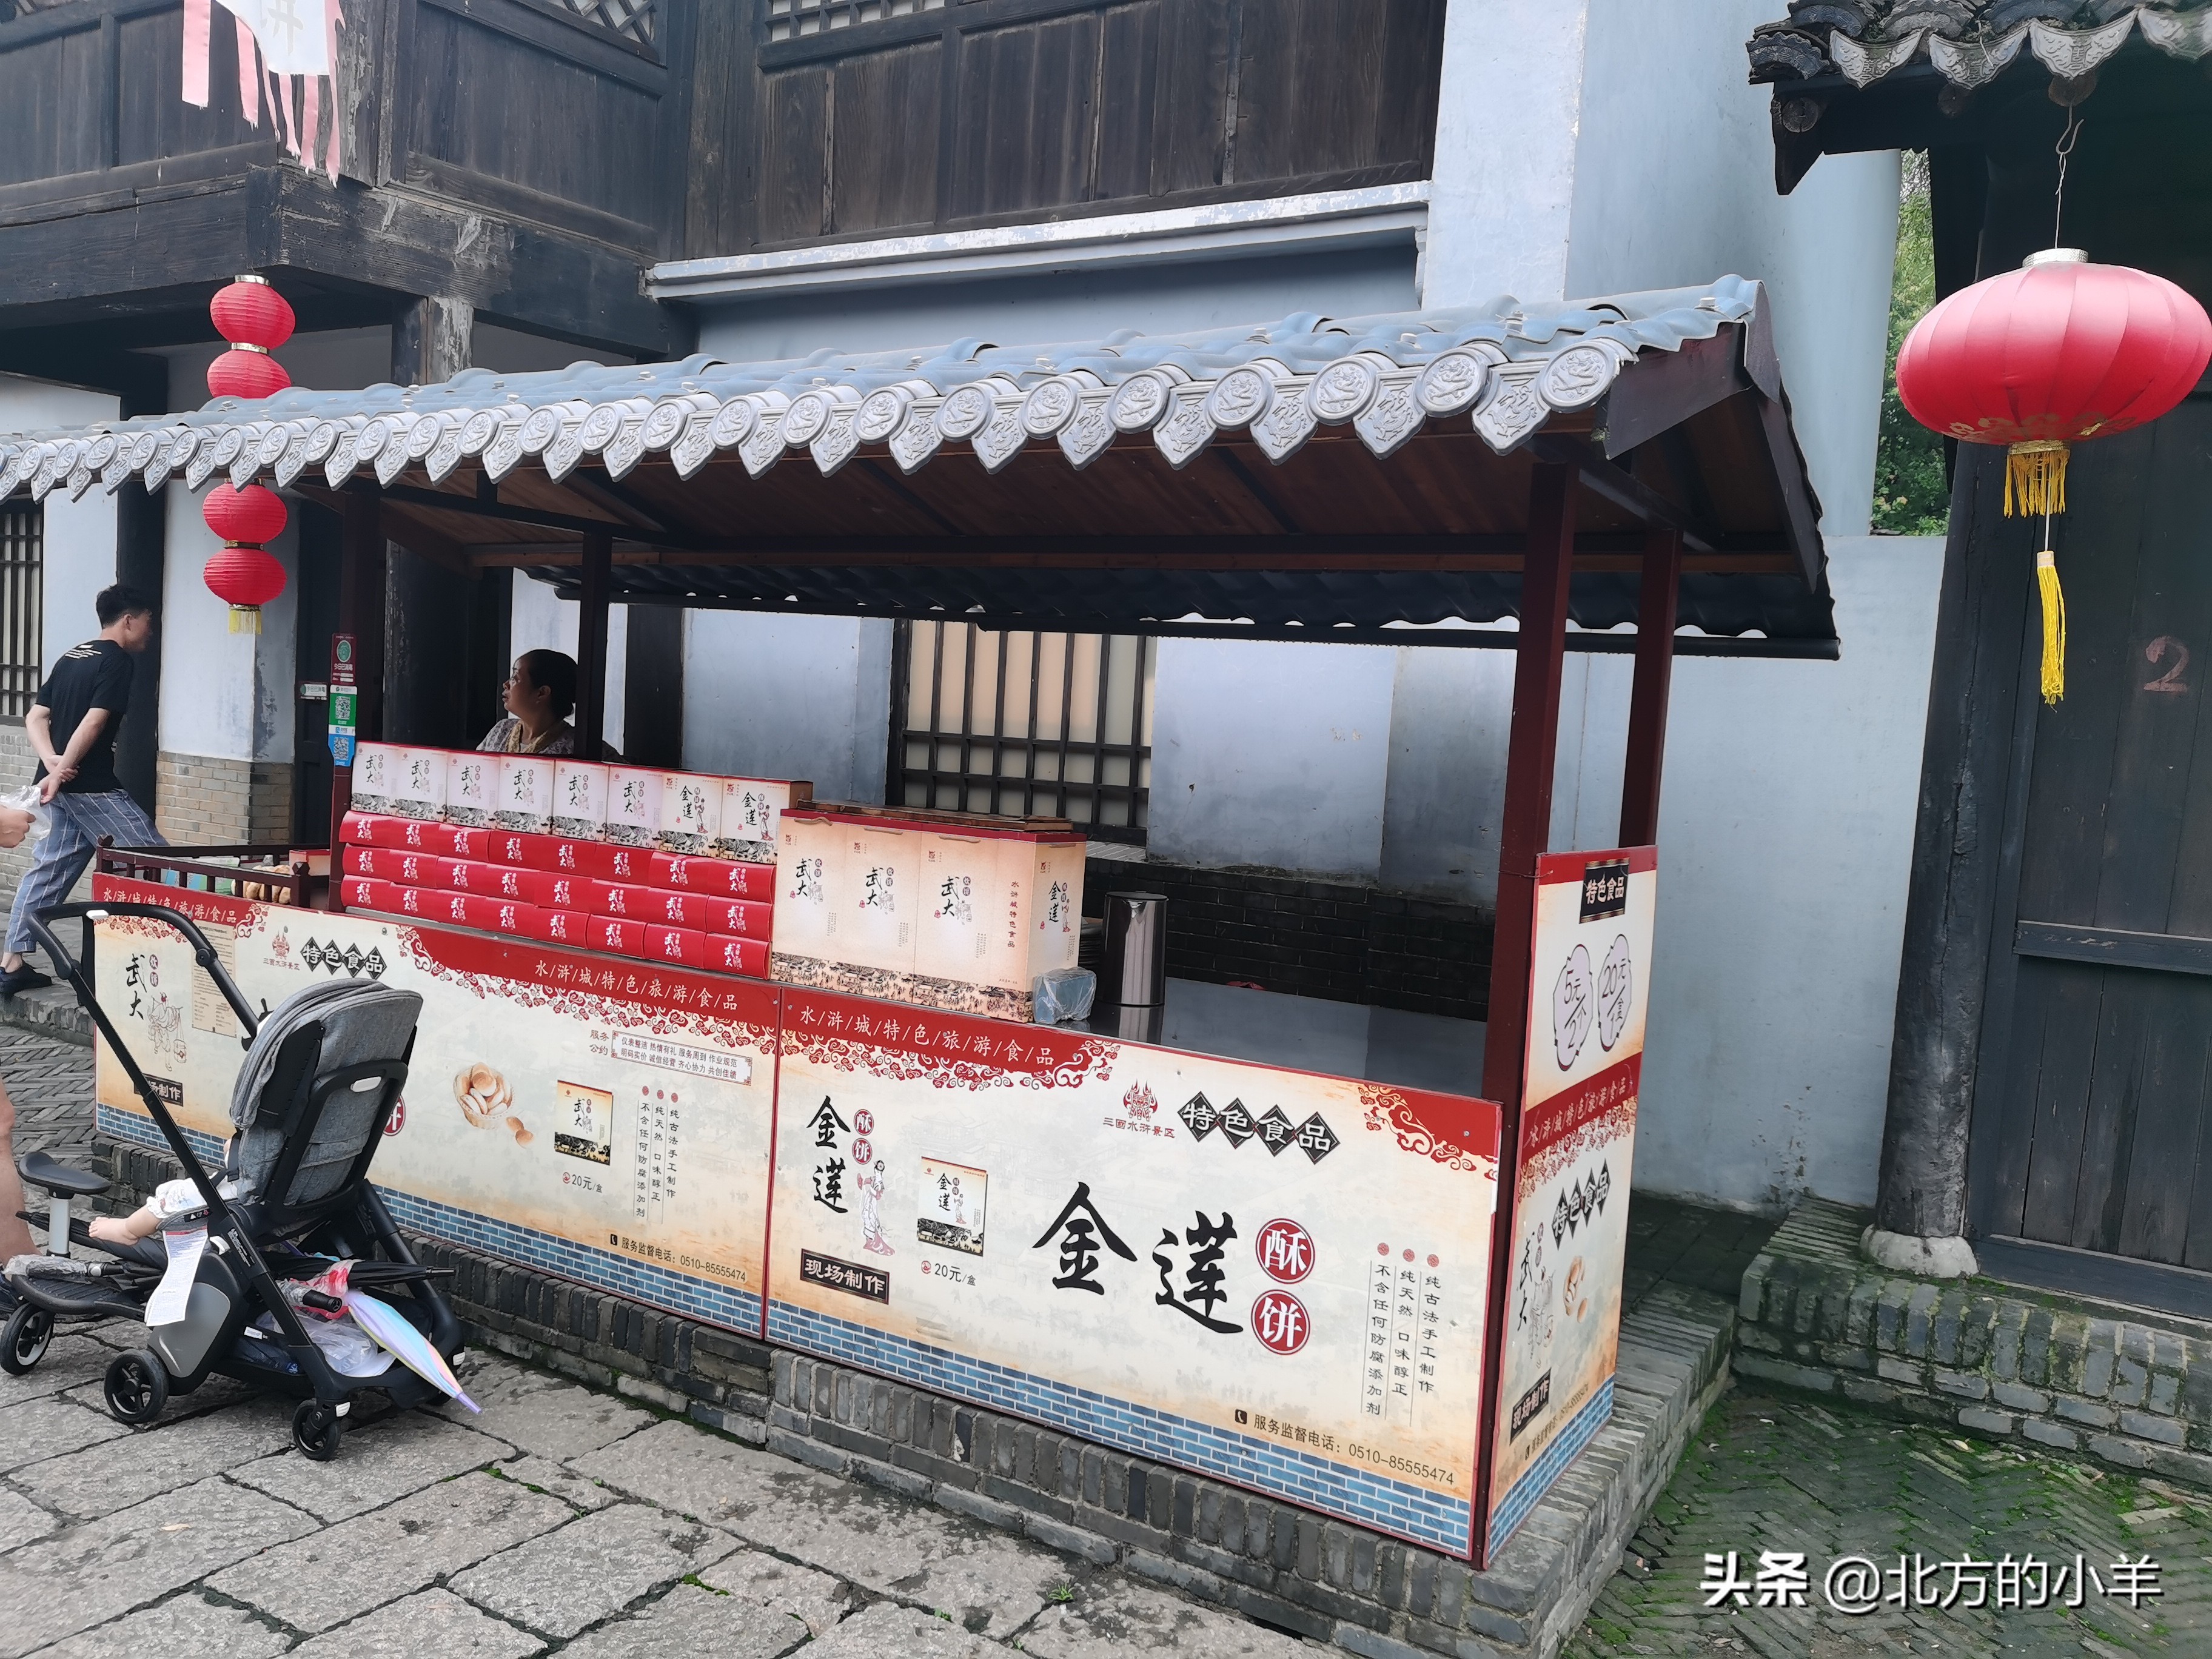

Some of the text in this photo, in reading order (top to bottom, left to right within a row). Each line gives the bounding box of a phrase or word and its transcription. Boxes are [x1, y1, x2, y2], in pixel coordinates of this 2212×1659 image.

[2144, 635, 2190, 692] 2
[366, 754, 377, 783] 武大
[411, 760, 423, 789] 武大
[461, 765, 473, 796] 武大
[514, 769, 526, 800] 武大
[569, 775, 581, 806] 武大
[623, 781, 635, 814] 武大
[679, 785, 694, 819] 金莲
[741, 791, 757, 826] 金莲
[796, 858, 813, 897] 武大
[866, 866, 884, 906] 武大
[941, 876, 959, 916] 武大
[1586, 877, 1625, 904] 特色食品
[1048, 880, 1061, 923] 金莲
[303, 944, 383, 974] 特色食品
[126, 953, 147, 1021] 武大
[147, 1080, 181, 1101] 场制作
[574, 1098, 585, 1128] 武大
[1182, 1103, 1332, 1153] 特色食品
[651, 1106, 665, 1202] 纯天然 口味醇正
[666, 1109, 680, 1199] 纯古法手工制作
[806, 1095, 851, 1213] 金莲
[853, 1111, 873, 1163] 酥饼
[636, 1102, 651, 1218] 不含任何防腐添加剂
[572, 1173, 603, 1194] 20元/盒
[936, 1173, 953, 1212] 金莲
[1553, 1171, 1610, 1239] 特色食品
[804, 1258, 886, 1295] 现场制作
[934, 1262, 976, 1287] 20元/盒
[1031, 1181, 1244, 1335] 金莲
[1256, 1224, 1311, 1352] 酥饼
[1366, 1264, 1391, 1416] 不含任何防腐添加剂
[1392, 1270, 1416, 1396] 纯天然 口味醇正
[1418, 1275, 1441, 1393] 纯古法手工制作
